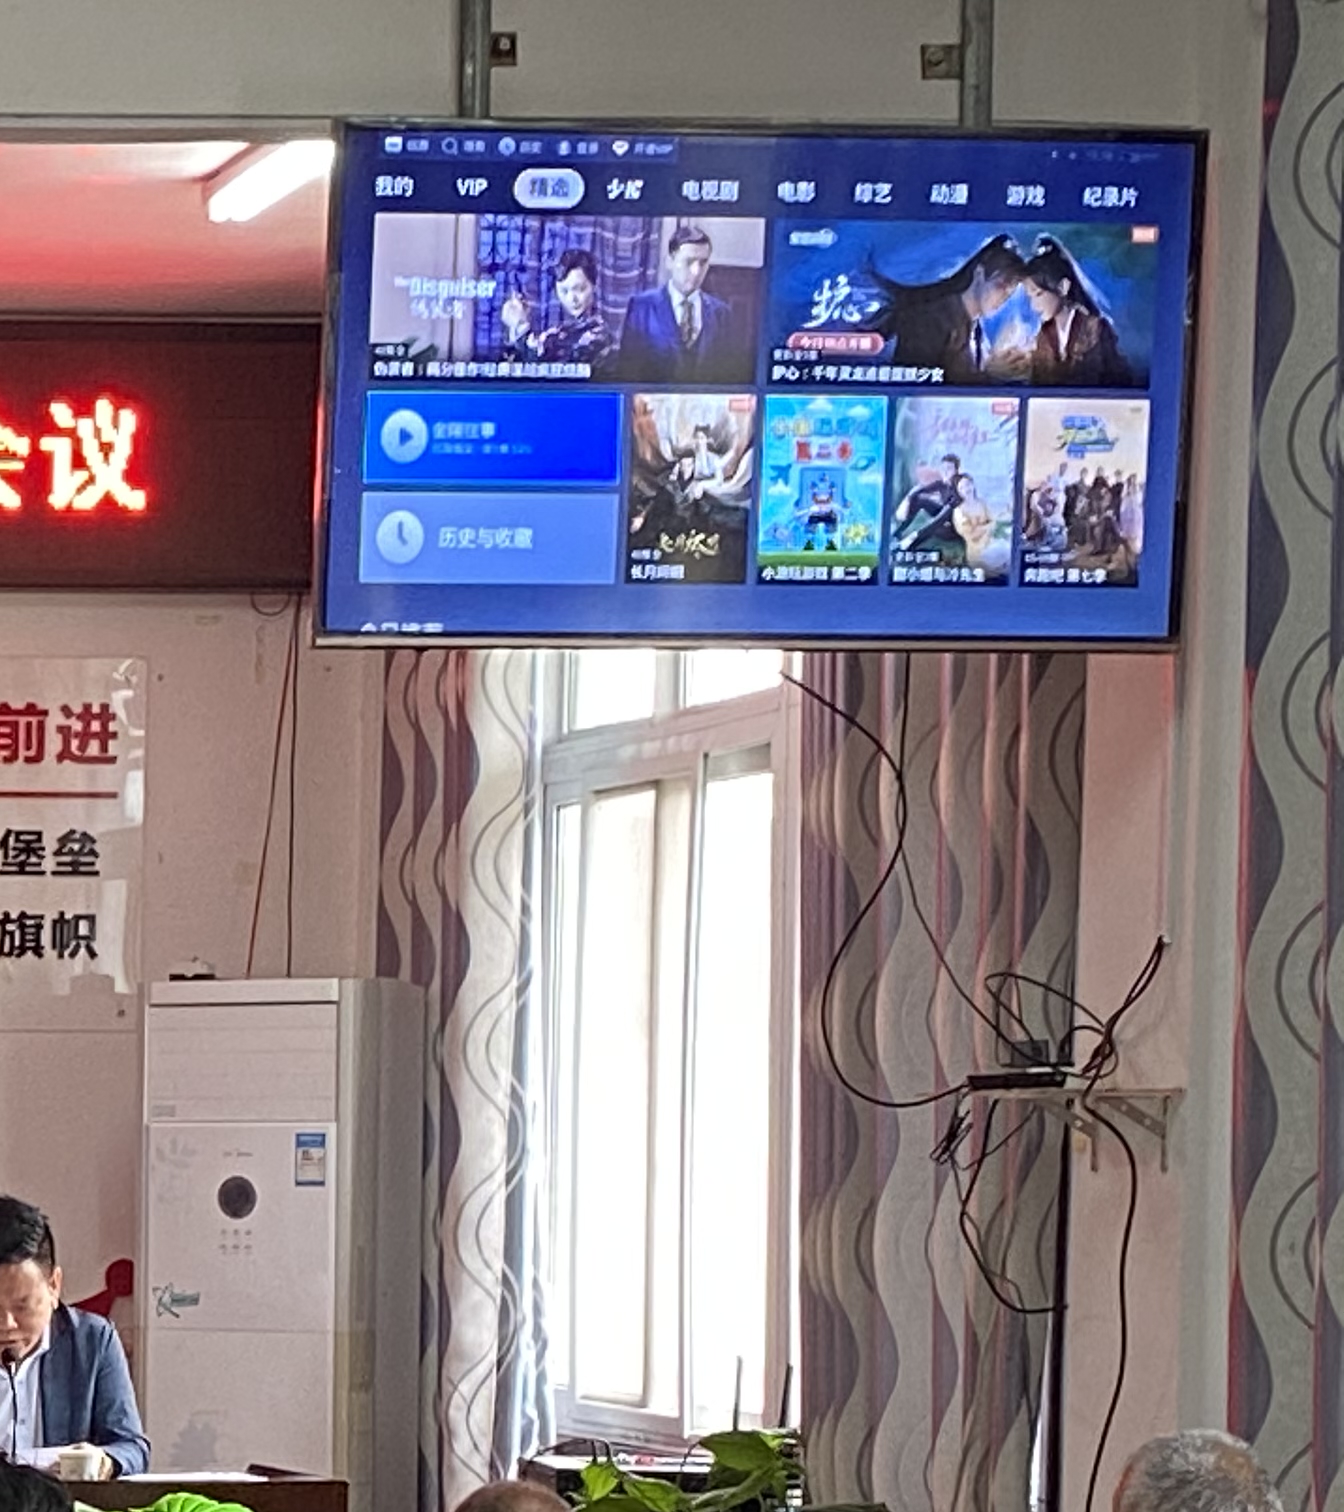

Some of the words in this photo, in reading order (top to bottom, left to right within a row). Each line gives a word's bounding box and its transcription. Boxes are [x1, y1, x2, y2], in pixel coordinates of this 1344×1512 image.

[375, 176, 413, 198] 我的
[456, 178, 488, 197] VIP
[607, 178, 644, 200] 少儿
[682, 180, 739, 203] 电视剧
[776, 181, 816, 204] 电影
[854, 182, 893, 205] 综艺
[930, 183, 969, 206] 动漫
[1006, 184, 1046, 207] 游戏
[1083, 186, 1139, 209] 纪录片
[438, 527, 533, 549] 历史与收藏
